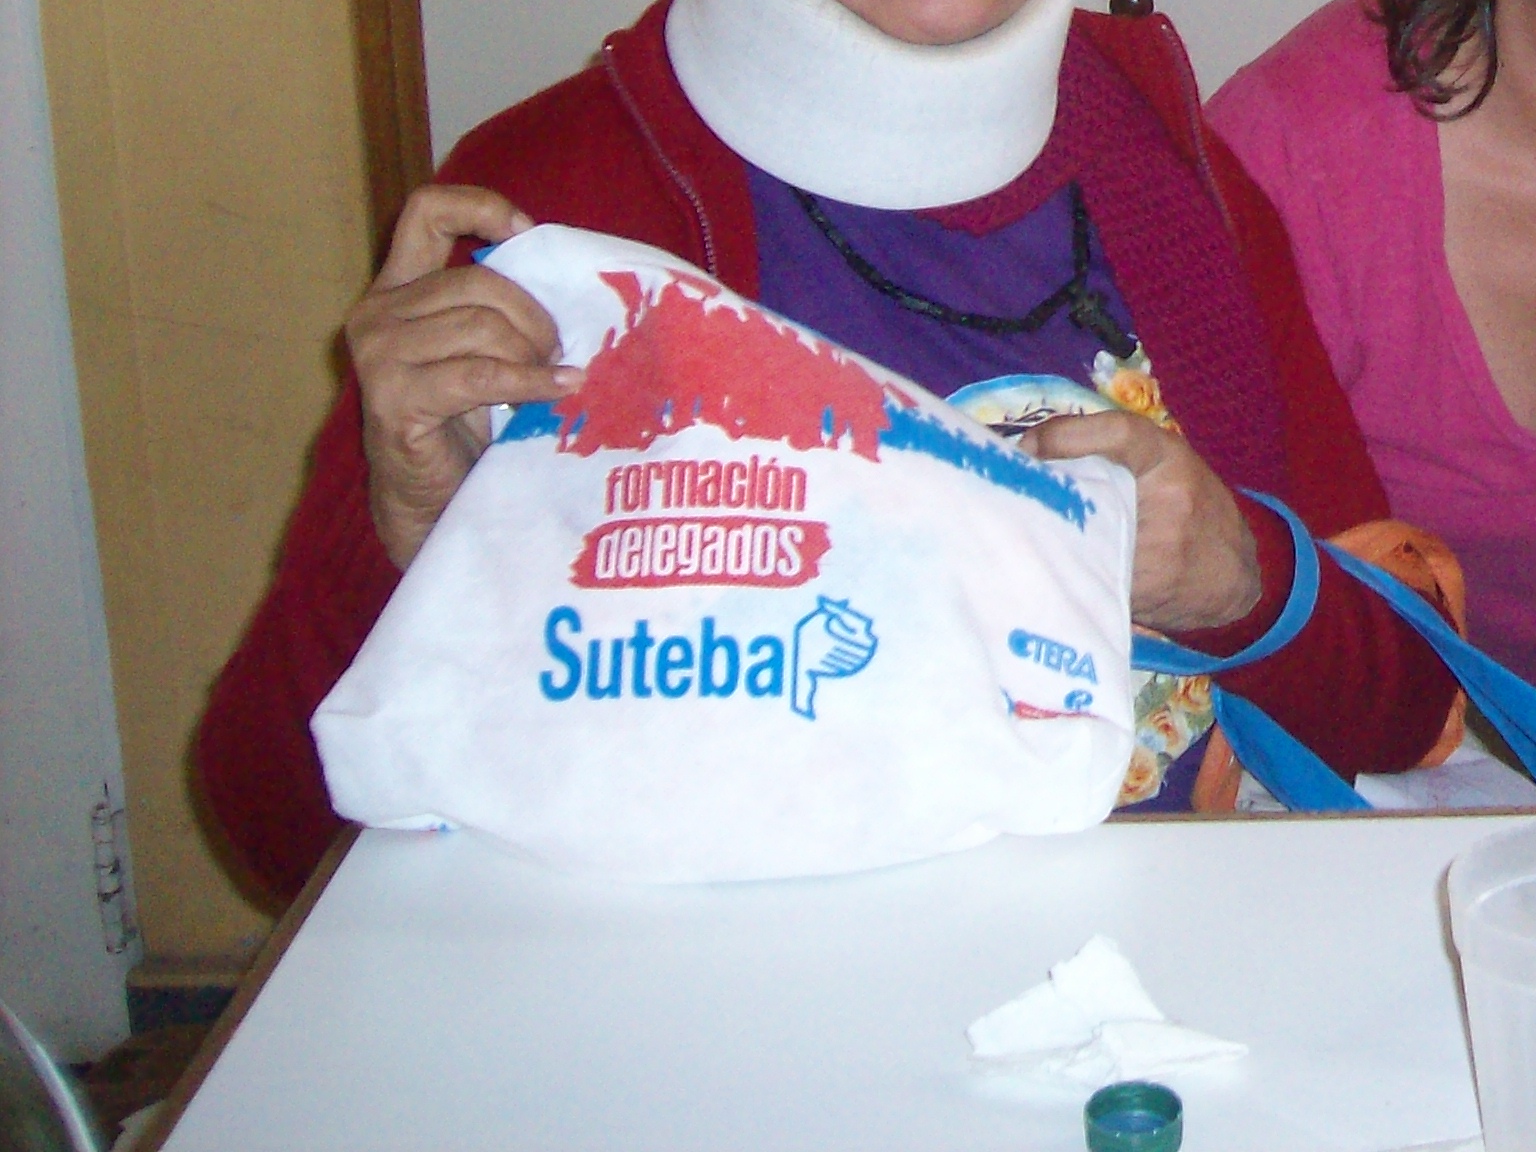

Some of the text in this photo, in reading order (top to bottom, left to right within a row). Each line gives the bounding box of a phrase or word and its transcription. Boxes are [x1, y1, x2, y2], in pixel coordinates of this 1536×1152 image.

[605, 454, 807, 515] formación
[594, 522, 803, 580] delegados
[538, 604, 785, 702] Suteba
